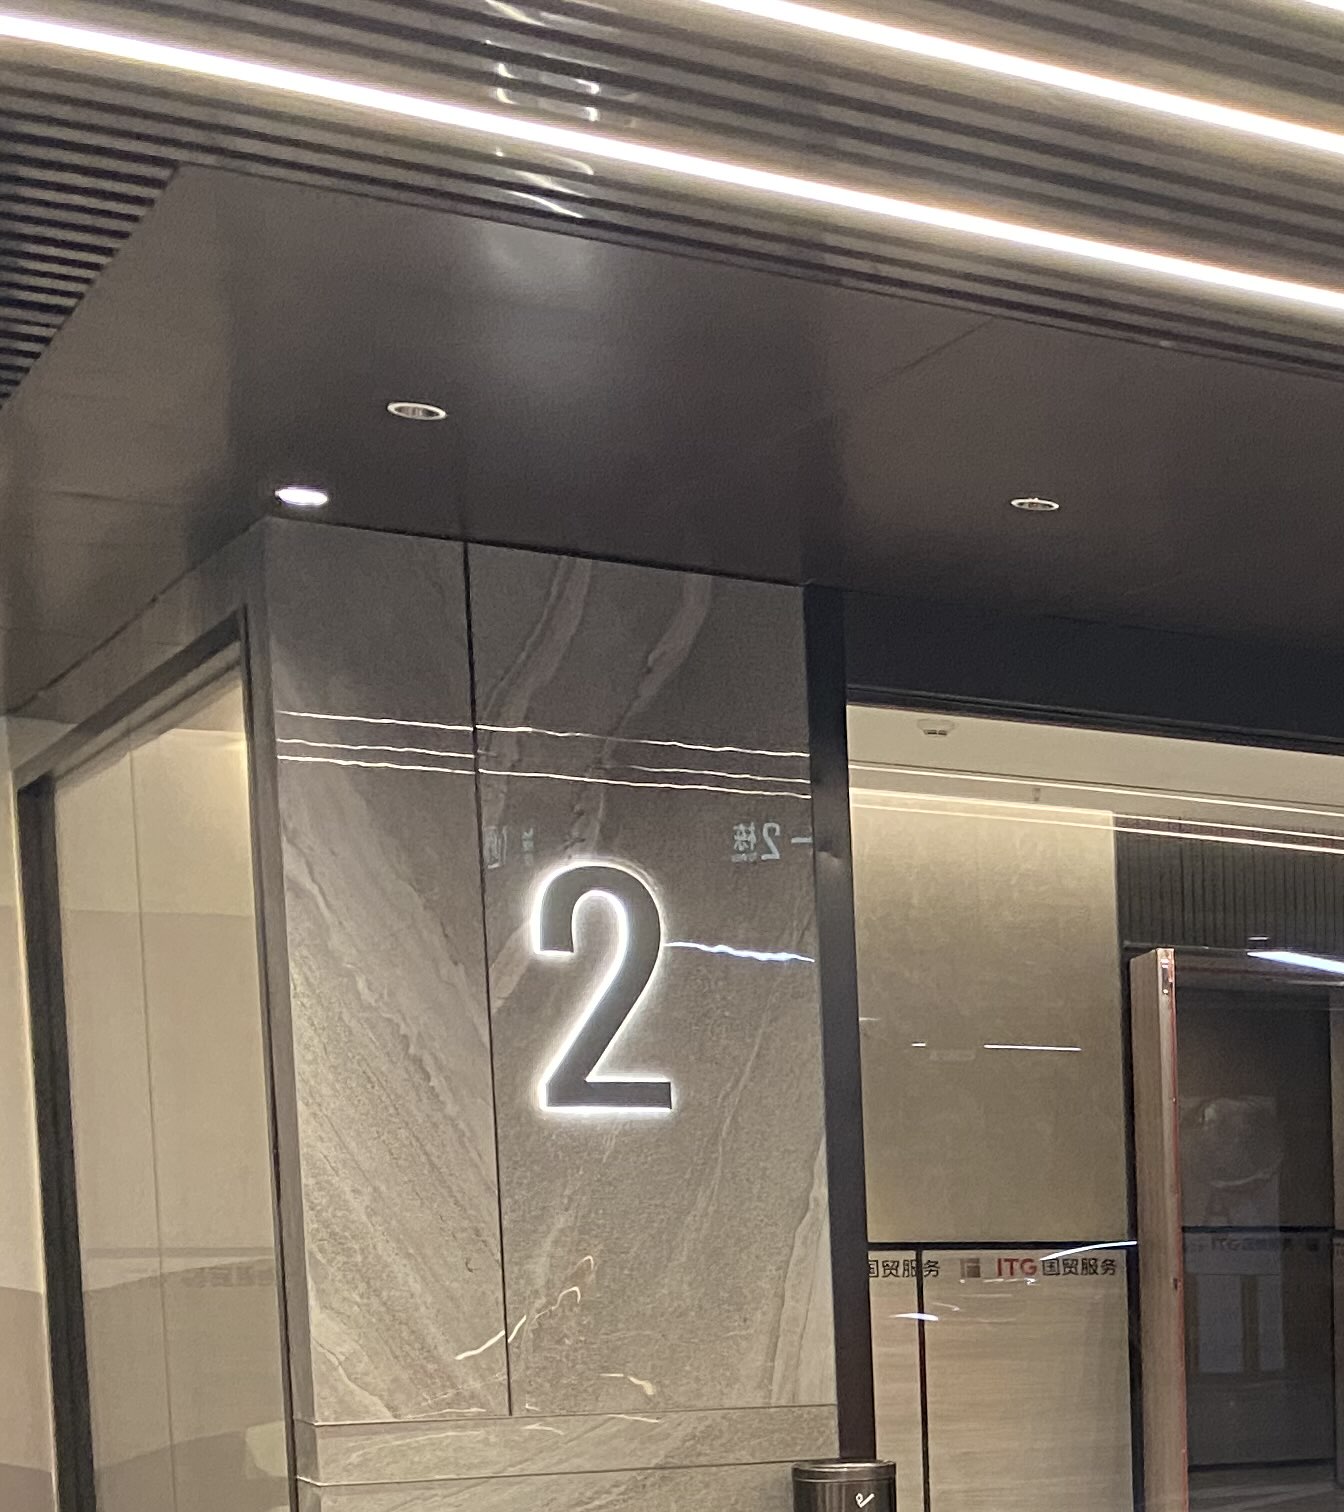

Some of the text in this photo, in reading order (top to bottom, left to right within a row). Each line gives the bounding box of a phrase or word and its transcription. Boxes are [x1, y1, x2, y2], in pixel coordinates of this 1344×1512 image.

[538, 863, 673, 1110] 2
[997, 1257, 1118, 1277] ITG 国贸服务
